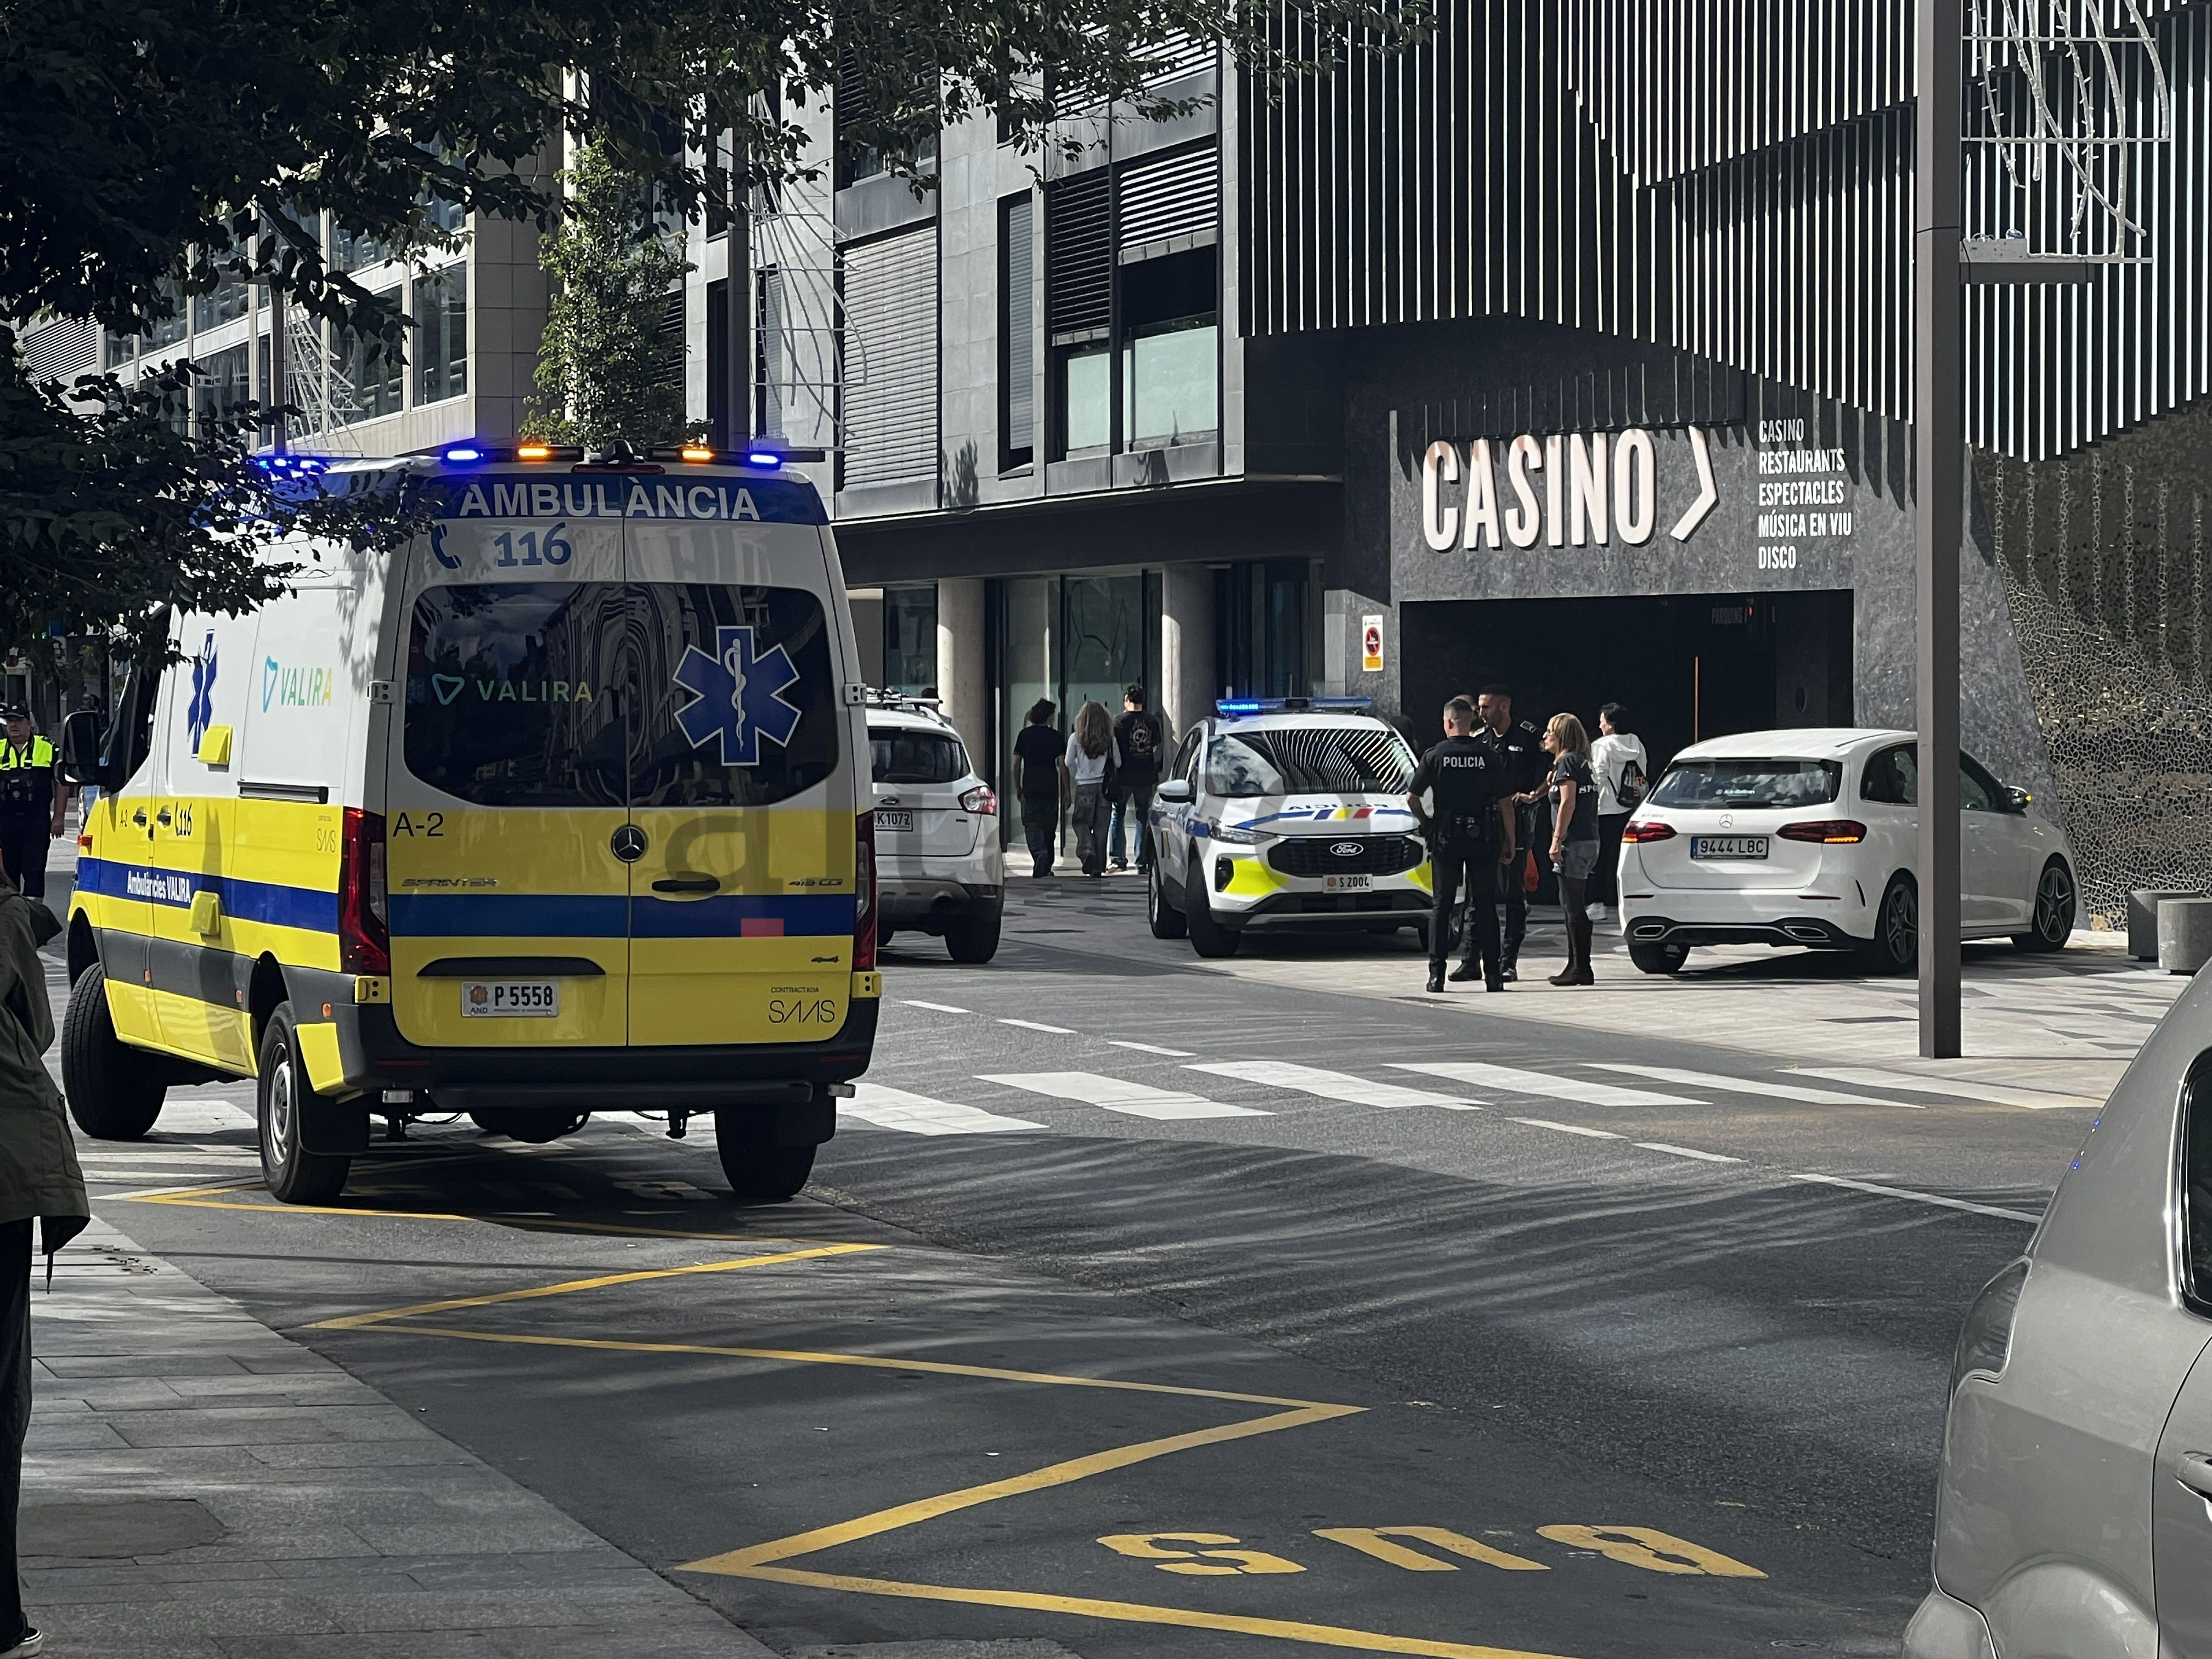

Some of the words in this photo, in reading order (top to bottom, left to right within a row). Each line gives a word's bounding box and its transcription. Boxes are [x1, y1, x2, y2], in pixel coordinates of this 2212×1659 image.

[1759, 419, 1804, 443] CASINO
[1759, 448, 1845, 474] RESTAURANTS
[459, 477, 760, 521] AMBULÀNCIA
[1423, 428, 1655, 550] CASINO
[1759, 480, 1844, 506] ESPECTACLES
[1758, 510, 1806, 537] MÚSICA
[1810, 513, 1826, 536] EN
[1830, 512, 1852, 535] VIU
[494, 522, 571, 567] 116
[1758, 546, 1796, 569] DISCO
[281, 668, 332, 706] VALIRA
[477, 680, 593, 702] VALIRA
[1443, 757, 1486, 768] POLICIA
[393, 812, 444, 837] A-2
[1336, 845, 1357, 853] Ford
[1701, 840, 1733, 853] 9444
[1739, 840, 1763, 853] LBC
[166, 876, 191, 904] VALIRA
[1340, 877, 1344, 887] S
[1347, 877, 1369, 887] 2004
[495, 986, 504, 1006] P
[510, 986, 553, 1006] 5558
[1096, 1525, 1769, 1578] BUS
